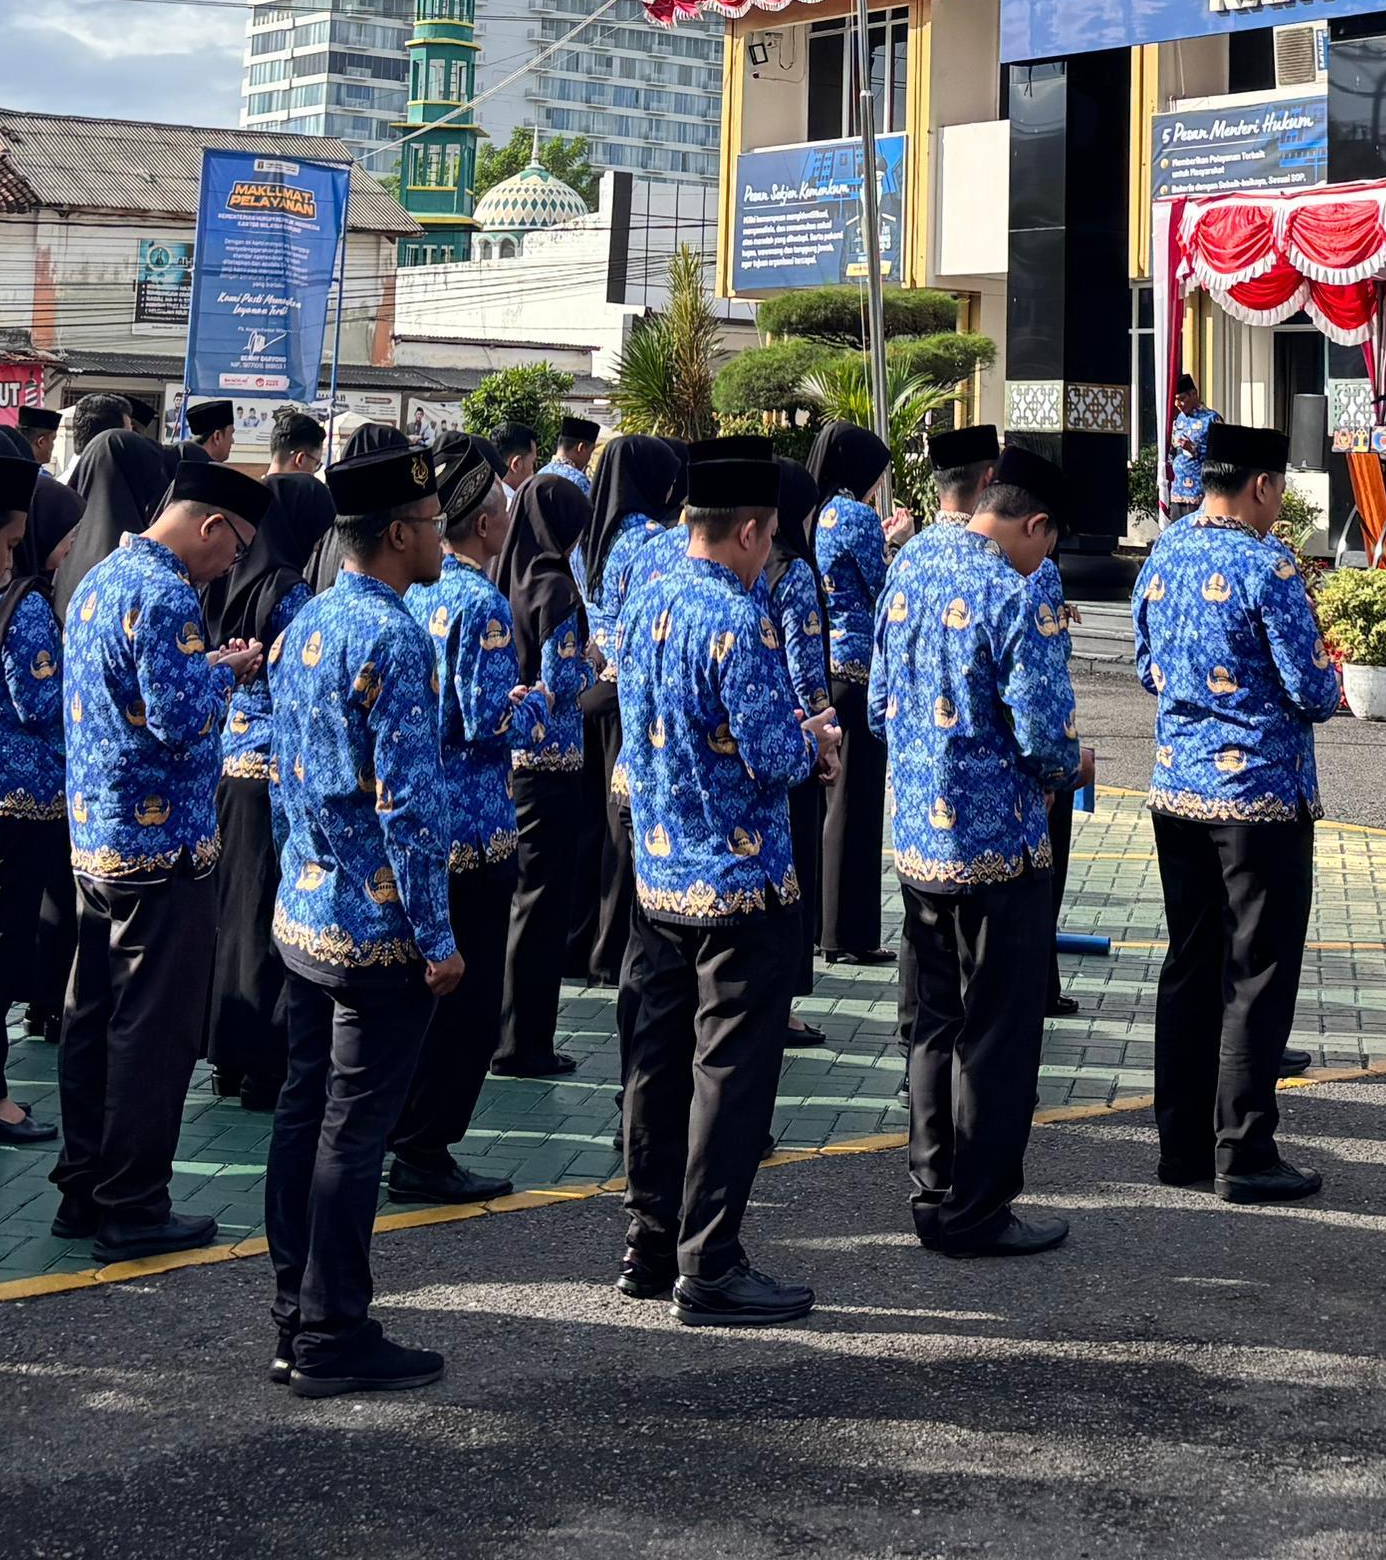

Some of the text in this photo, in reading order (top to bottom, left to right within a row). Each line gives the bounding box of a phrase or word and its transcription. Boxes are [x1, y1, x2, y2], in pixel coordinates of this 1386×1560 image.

[1162, 110, 1314, 144] 5 Pesan Menteri Hukum
[743, 184, 770, 203] Pesan
[229, 195, 314, 216] PELAYANAN
